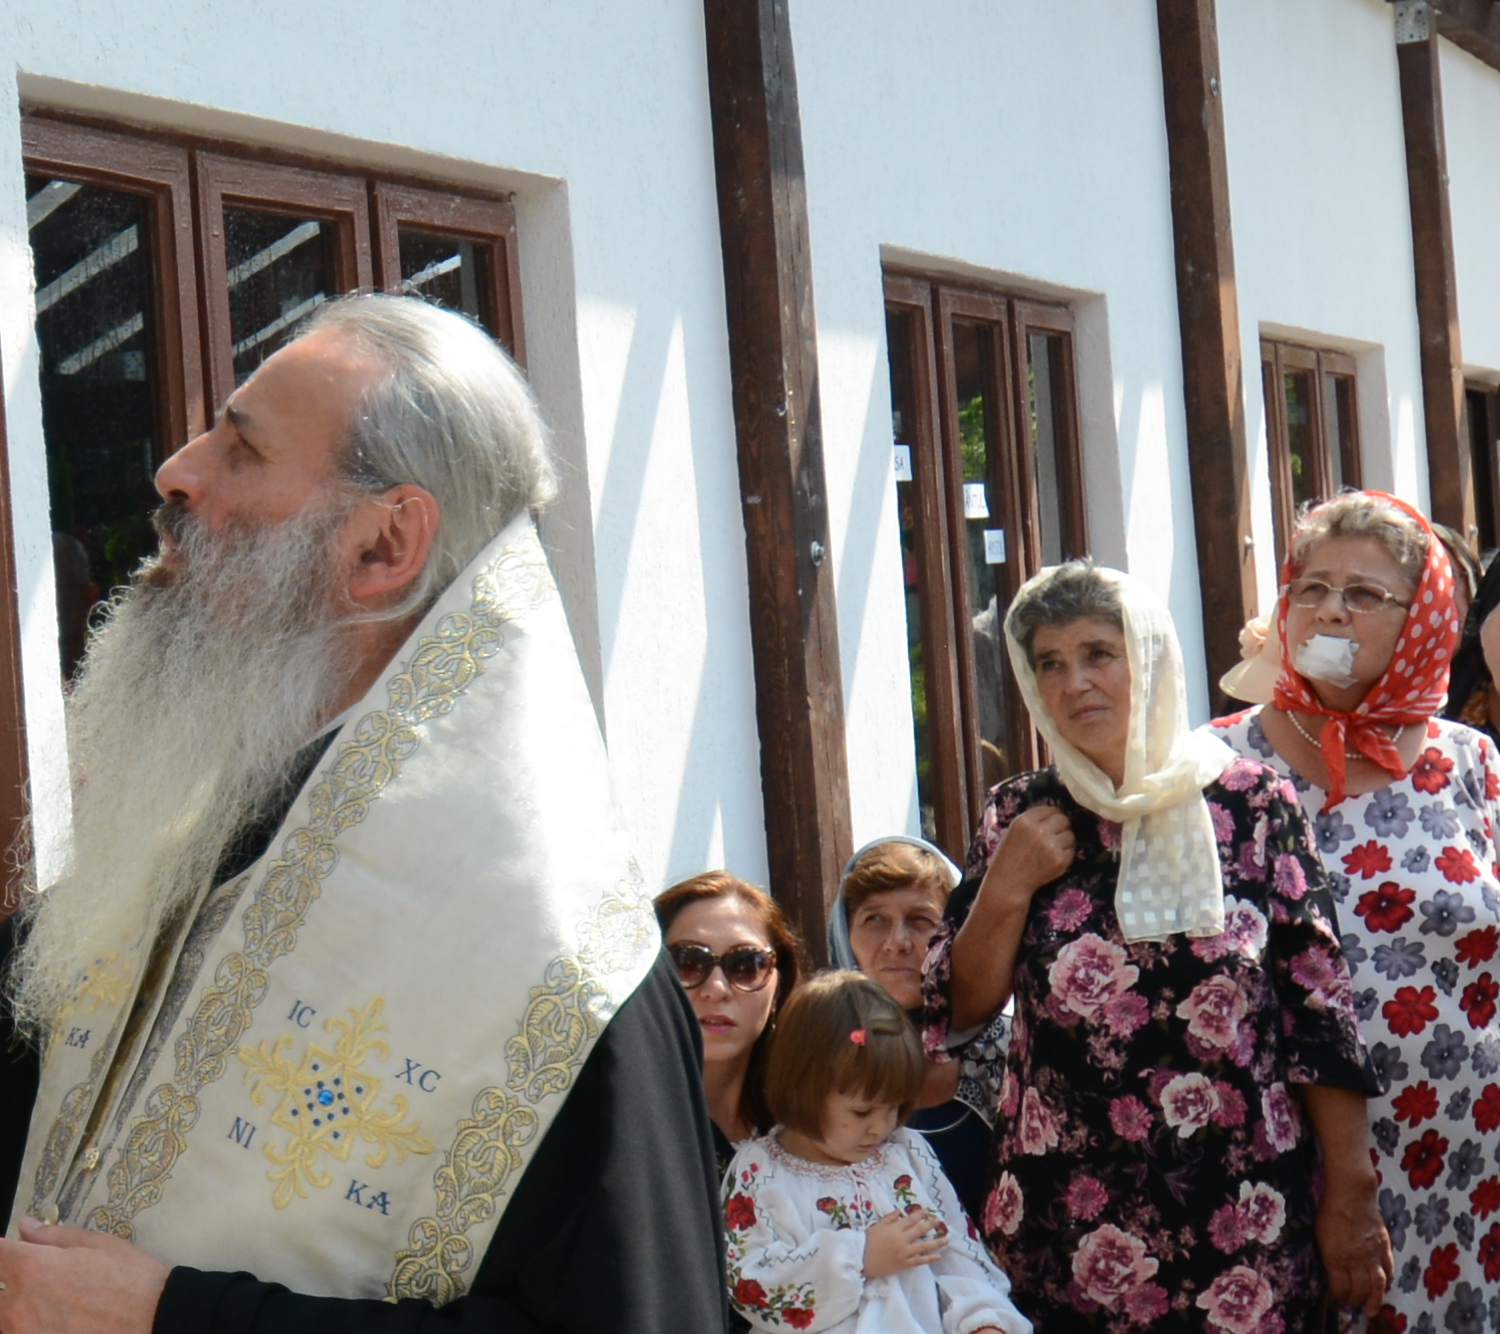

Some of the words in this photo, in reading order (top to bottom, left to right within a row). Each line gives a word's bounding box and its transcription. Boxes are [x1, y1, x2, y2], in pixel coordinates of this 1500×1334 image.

[65, 1027, 91, 1049] KA
[287, 999, 317, 1028] IC
[394, 1057, 442, 1094] XC
[227, 1116, 257, 1149] NI
[344, 1179, 391, 1216] KA
